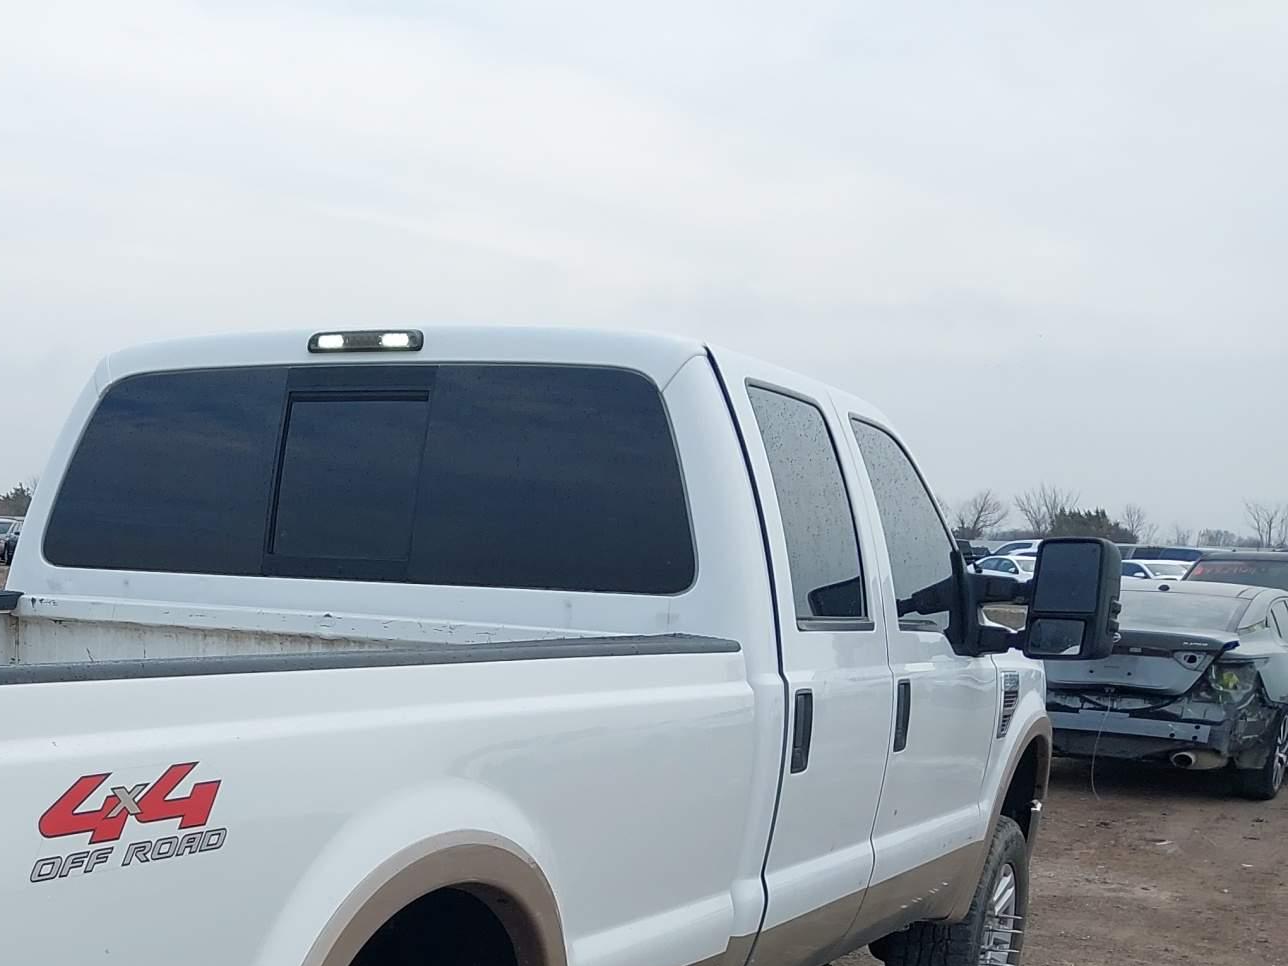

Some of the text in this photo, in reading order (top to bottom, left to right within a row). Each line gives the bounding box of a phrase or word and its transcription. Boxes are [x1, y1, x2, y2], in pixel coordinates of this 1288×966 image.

[38, 761, 222, 845] 4x4
[30, 827, 228, 883] OFF ROAD
